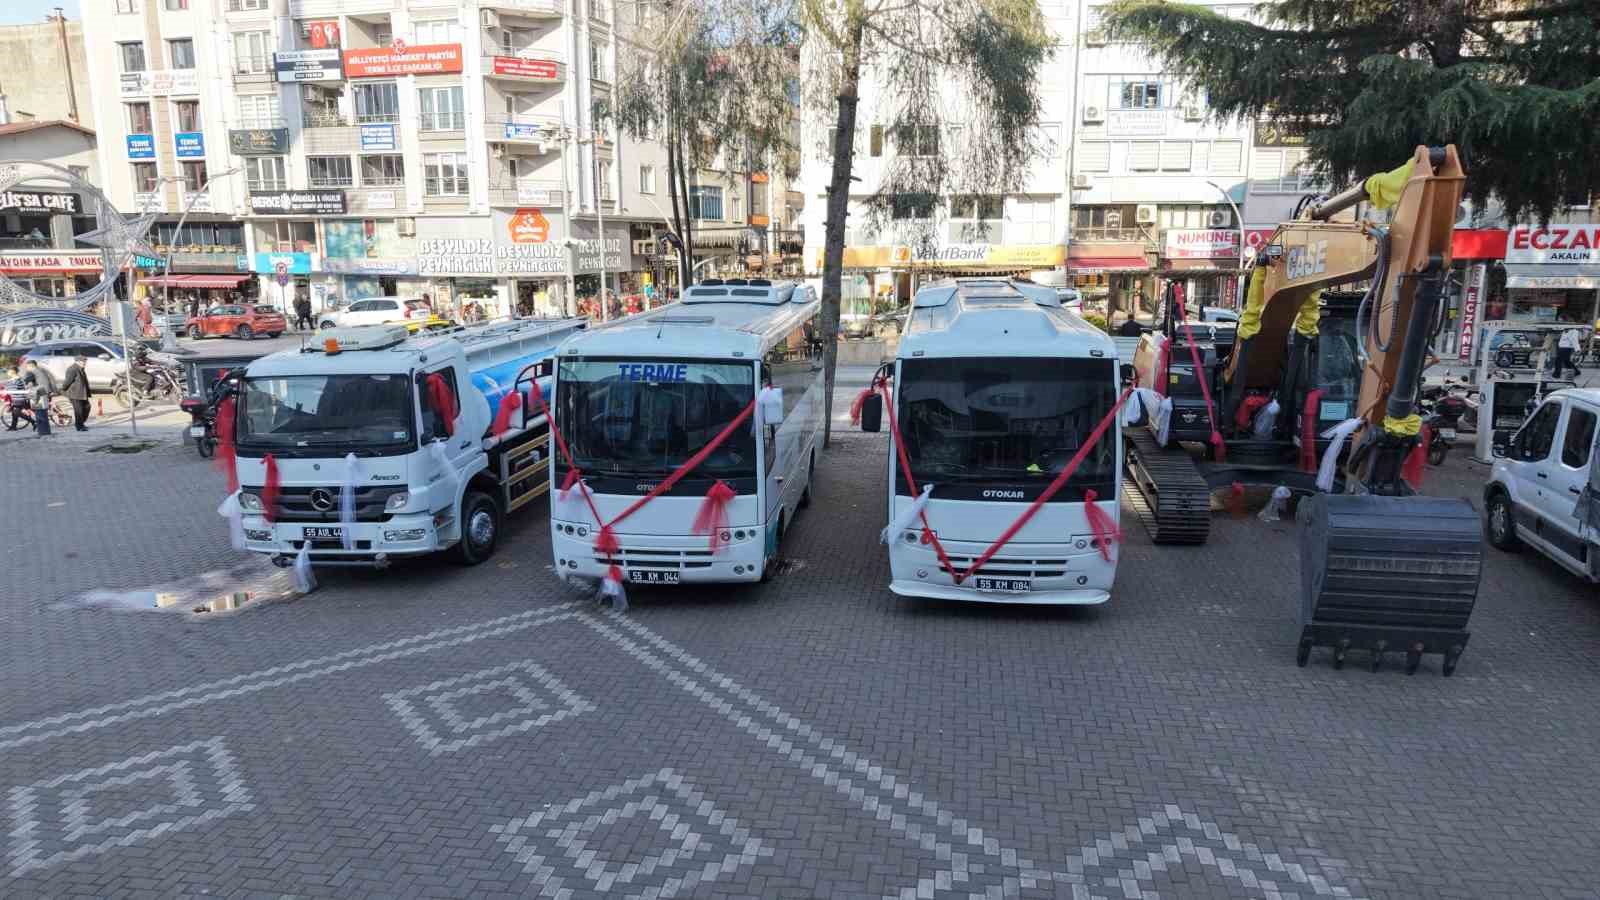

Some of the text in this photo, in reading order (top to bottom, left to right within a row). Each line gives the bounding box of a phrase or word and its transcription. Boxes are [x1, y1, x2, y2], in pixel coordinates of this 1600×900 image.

[43, 194, 75, 212] CAFE
[1287, 241, 1328, 280] CASE
[1551, 252, 1590, 260] AKALIN
[1, 257, 31, 266] AYDIN
[35, 257, 59, 266] KASA
[1461, 292, 1476, 356] ECZANE
[618, 363, 689, 384] TERME
[983, 490, 1024, 499] OTOKAR
[306, 528, 316, 536] 55
[632, 571, 642, 580] 55
[648, 572, 658, 581] KM
[980, 580, 991, 589] 55
